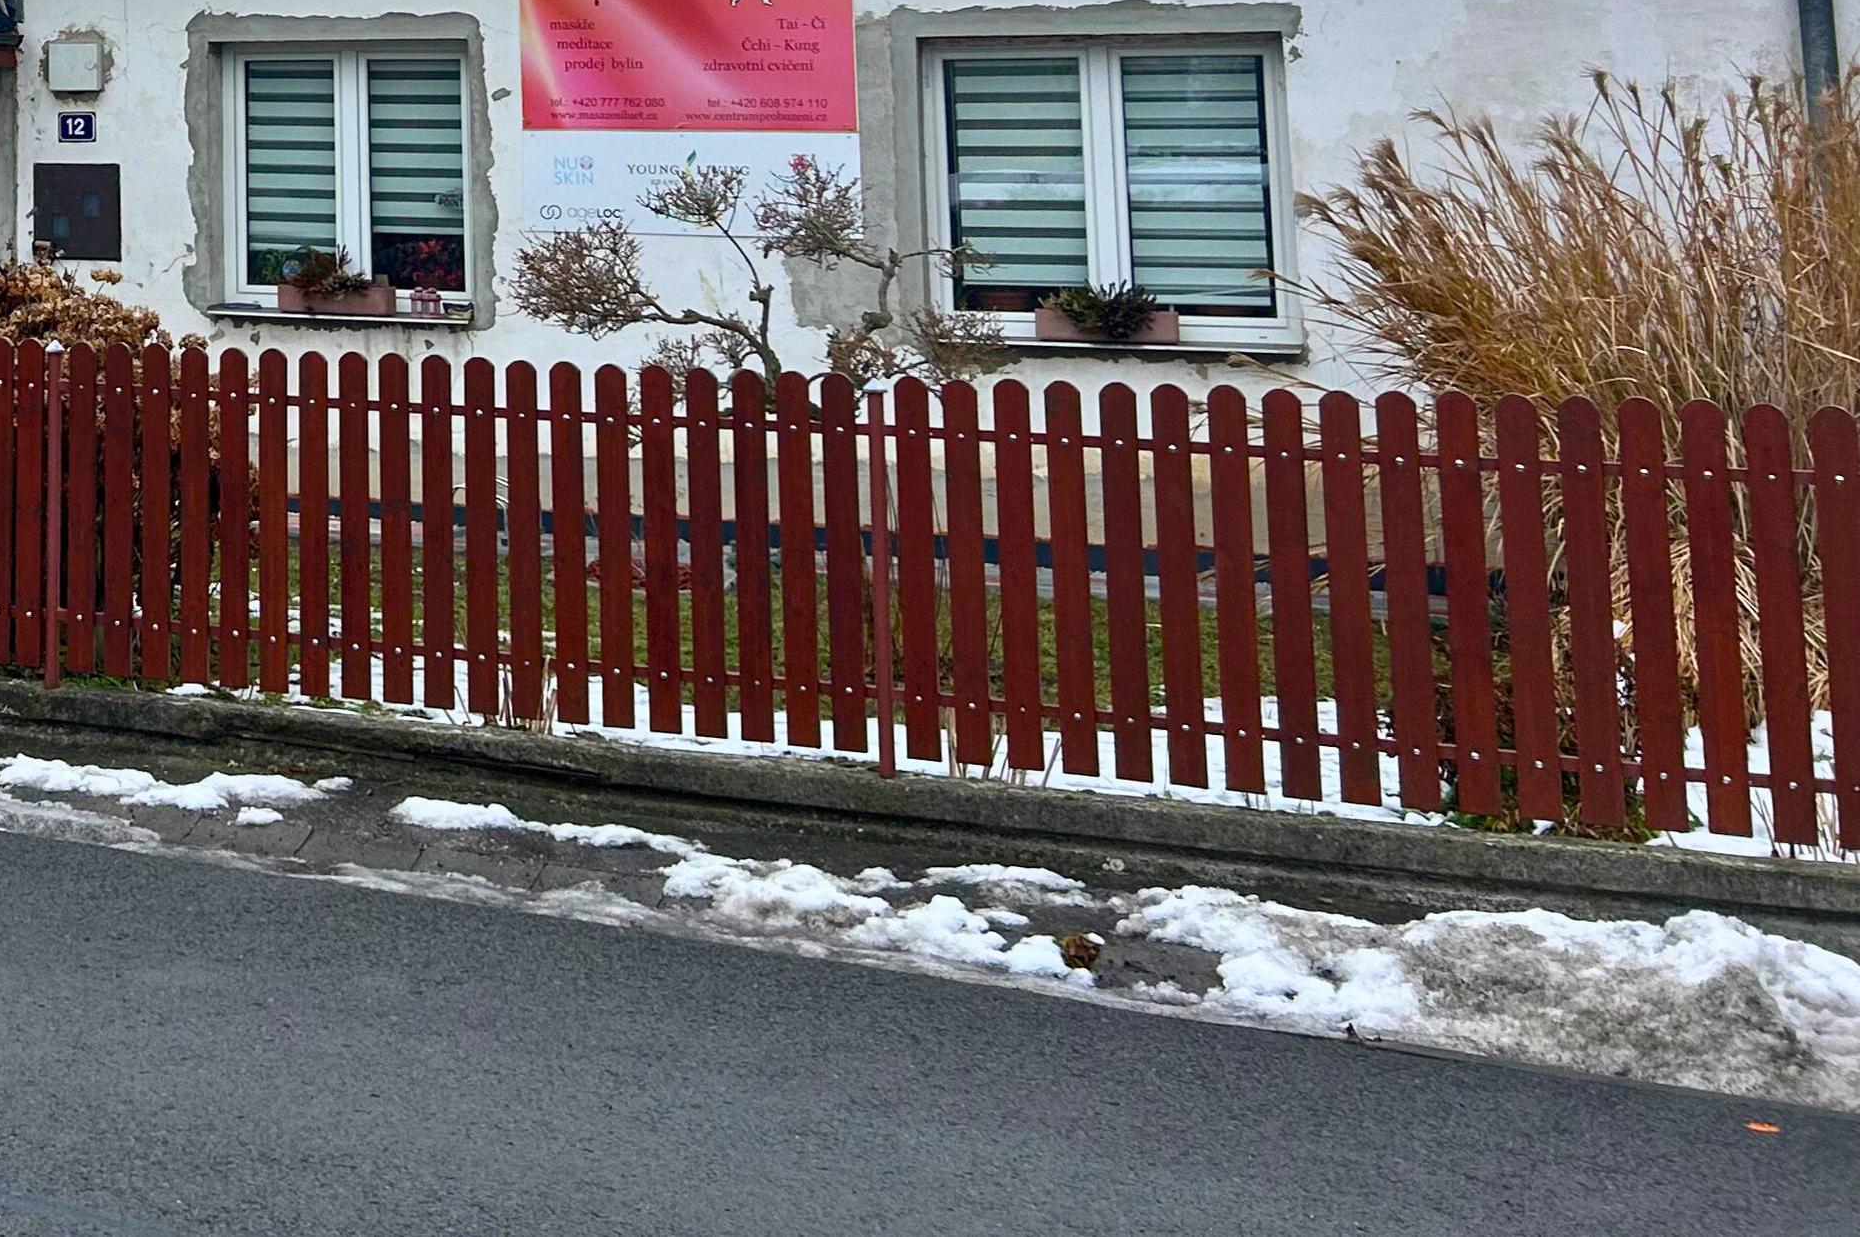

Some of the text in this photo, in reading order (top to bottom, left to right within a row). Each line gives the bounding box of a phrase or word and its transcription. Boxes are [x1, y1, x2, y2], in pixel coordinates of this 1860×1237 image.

[549, 18, 595, 31] masáže
[776, 17, 799, 30] Tai
[556, 37, 613, 50] meditace
[784, 39, 820, 54] Kung
[564, 56, 644, 73] prodej bylin
[572, 97, 598, 108] +420
[601, 97, 620, 108] 777
[731, 98, 757, 109] +420
[807, 98, 828, 109] 110
[66, 117, 85, 136] 12
[554, 156, 578, 170] NU
[627, 164, 680, 175] YOUNG
[554, 171, 594, 185] SKIN
